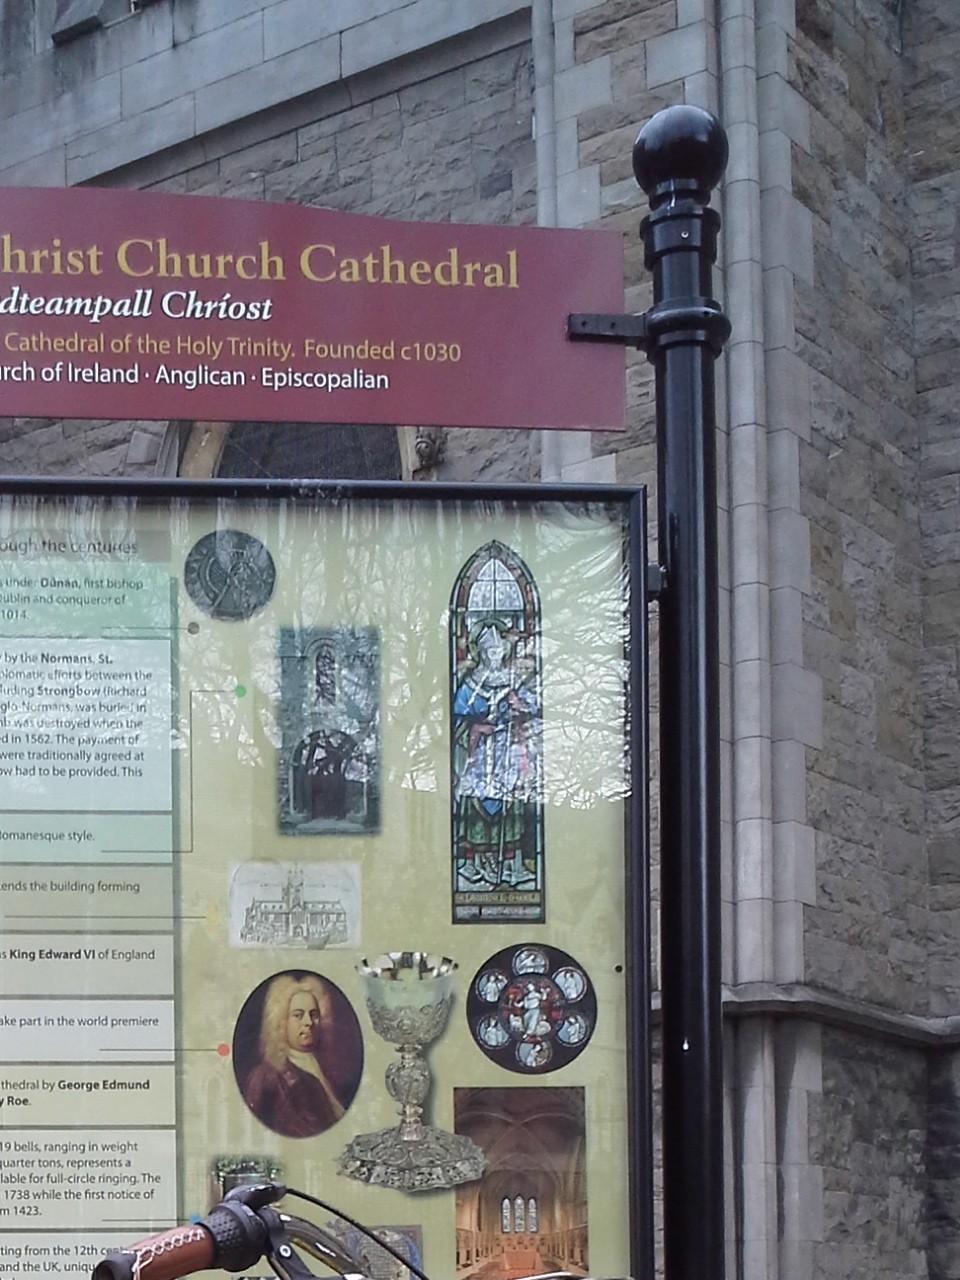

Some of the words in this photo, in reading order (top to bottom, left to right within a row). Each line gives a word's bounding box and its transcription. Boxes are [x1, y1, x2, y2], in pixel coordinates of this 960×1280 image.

[116, 238, 286, 280] Church
[300, 244, 519, 288] Cathedral
[162, 291, 272, 320] Chríost
[4, 332, 104, 353] Cathedral
[111, 333, 133, 353] of
[137, 334, 170, 355] the
[177, 335, 223, 361] Holy
[227, 337, 295, 362] Trinity.
[305, 339, 394, 360] Founded
[400, 343, 461, 362] c1030
[41, 362, 63, 381] of
[68, 362, 139, 383] Ireland
[155, 364, 245, 389] Anglican
[262, 368, 388, 392] Episcopalian
[68, 830, 94, 843] style.
[30, 881, 47, 891] the
[51, 881, 95, 893] building
[98, 881, 140, 894] forming
[10, 950, 35, 961] King
[39, 949, 81, 959] Edward
[84, 950, 95, 959] VI
[98, 949, 108, 959] of
[112, 950, 155, 962] England
[20, 1017, 41, 1028] part
[45, 1016, 54, 1026] in
[57, 1016, 75, 1026] the
[78, 1016, 108, 1026] world
[111, 1017, 159, 1028] premiere
[42, 1080, 55, 1092] by
[58, 1080, 99, 1092] George
[103, 1080, 150, 1089] Edmund
[8, 1096, 31, 1105] Roe.
[0, 1142, 11, 1152] 19
[14, 1142, 41, 1152] bells,
[44, 1142, 85, 1154] ranging
[89, 1142, 98, 1151] in
[102, 1142, 138, 1154] weight
[29, 1173, 44, 1183] for
[47, 1173, 95, 1183] full-circle
[99, 1174, 139, 1185] ringing.
[143, 1173, 161, 1183] The
[25, 1245, 50, 1256] from
[53, 1246, 70, 1256] the
[75, 1245, 102, 1255] 12th
[0, 1262, 20, 1272] and
[23, 1262, 40, 1272] the
[44, 1262, 61, 1272] UK,
